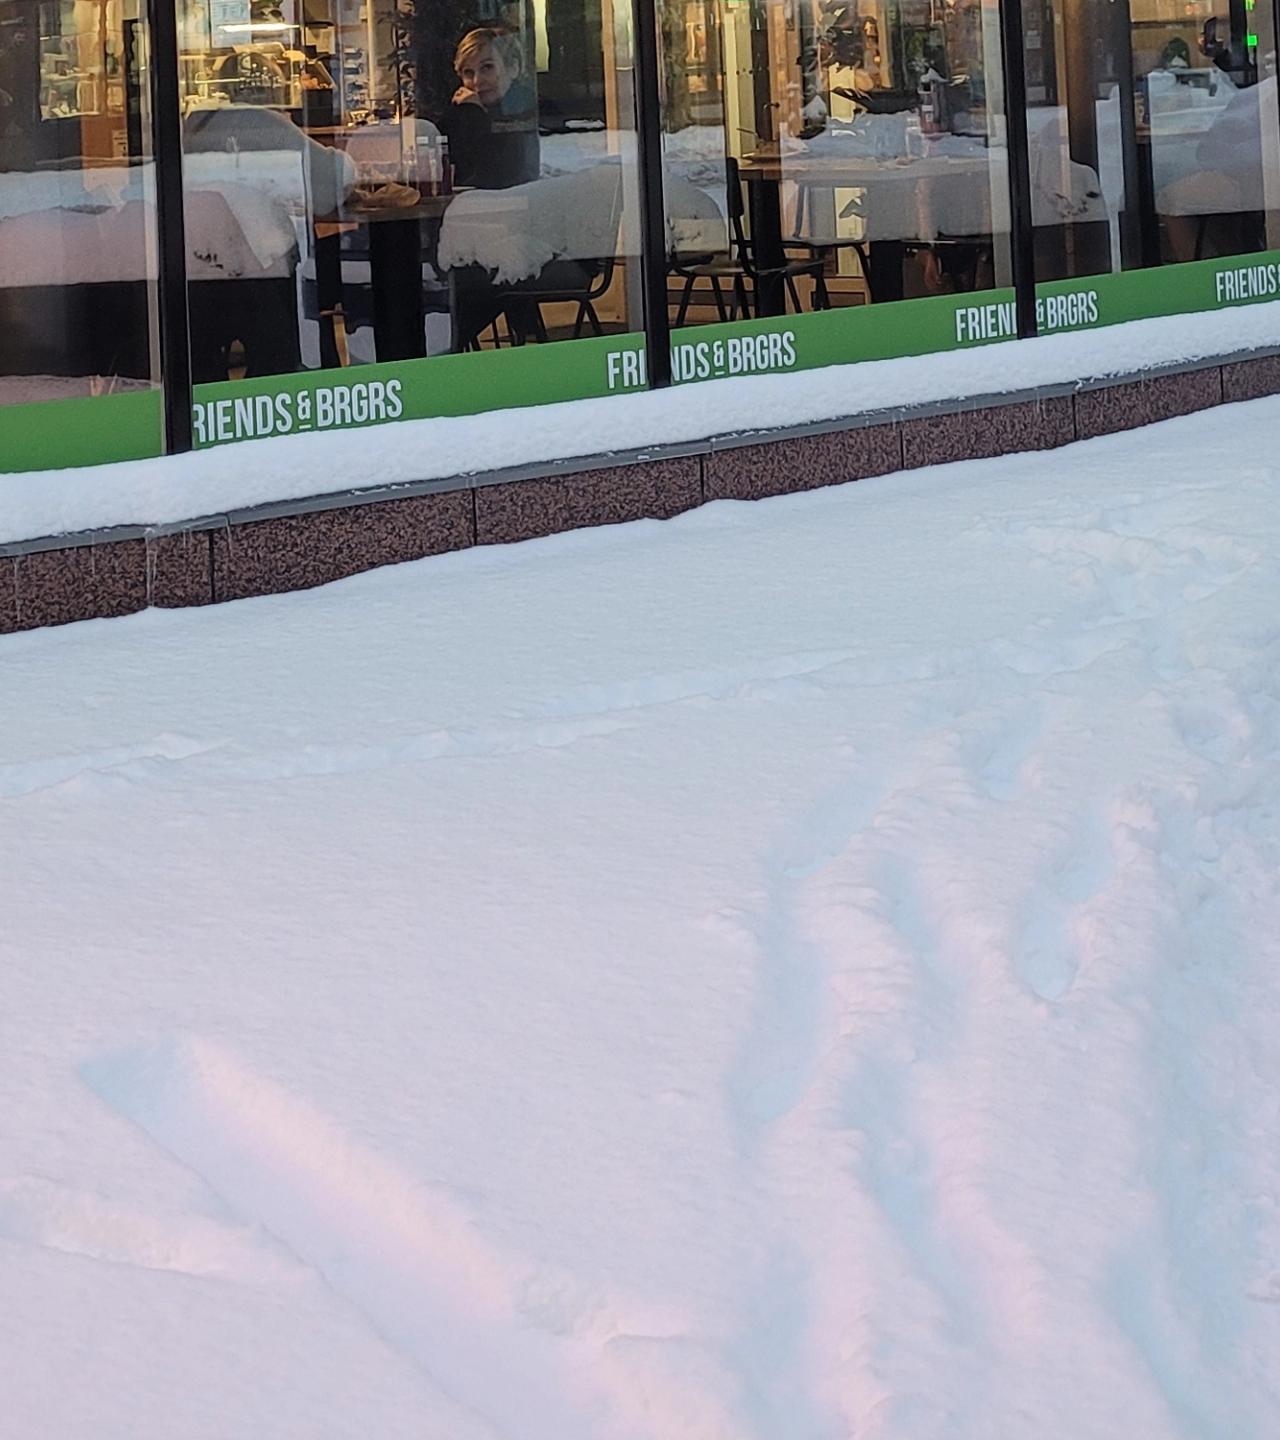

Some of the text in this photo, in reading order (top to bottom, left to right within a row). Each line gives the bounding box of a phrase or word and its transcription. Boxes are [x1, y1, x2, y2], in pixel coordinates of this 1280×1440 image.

[1215, 264, 1277, 302] FRIENDS
[955, 302, 1018, 342] FRIEN
[1046, 291, 1098, 328] BRGRS
[607, 331, 796, 389] FRINDS & BRGRS
[193, 379, 403, 443] RIENDS & BRGRS
